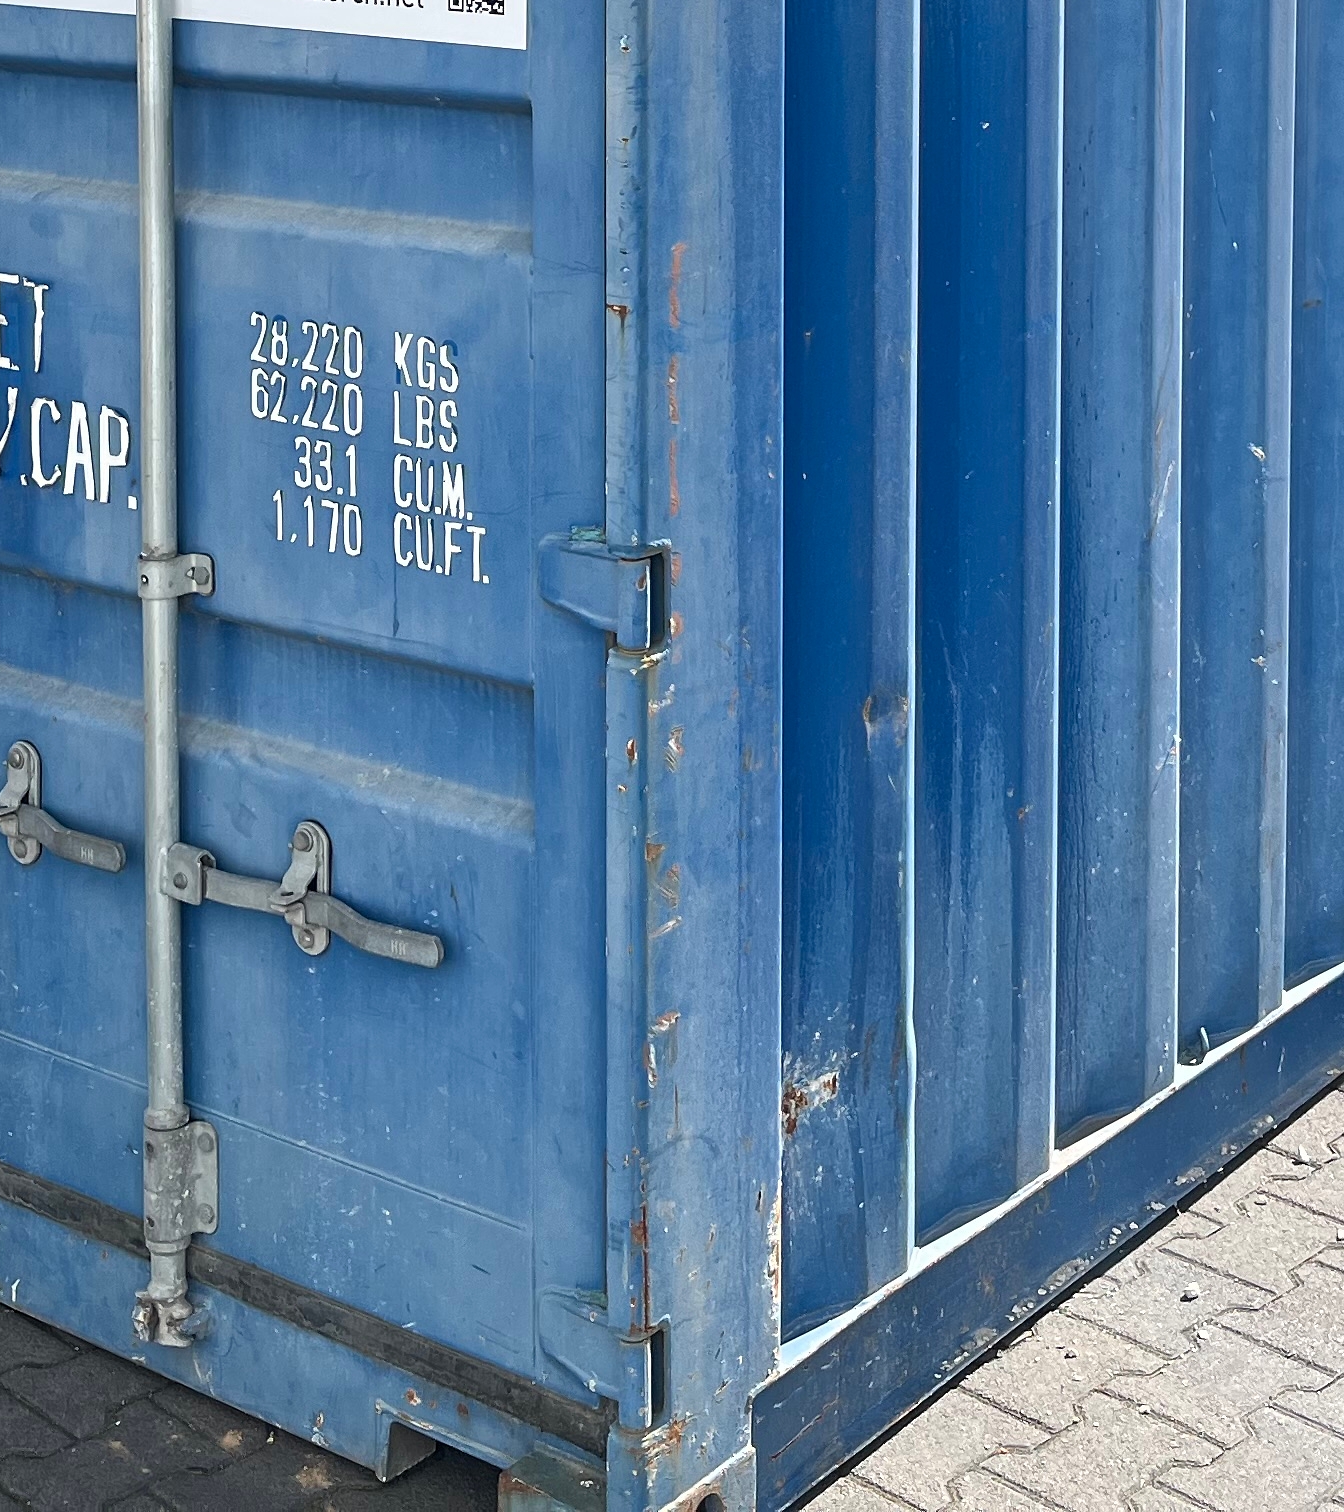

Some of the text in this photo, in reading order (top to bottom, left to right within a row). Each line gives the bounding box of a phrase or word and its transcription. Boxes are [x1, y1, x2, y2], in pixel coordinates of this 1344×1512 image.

[250, 311, 364, 379] 28,220
[393, 331, 460, 393] KGS
[251, 367, 459, 453] 62,220 LBS
[293, 436, 357, 497] 33.1
[393, 453, 474, 521] CU.M.
[272, 489, 491, 585] 1,170 CU.FT.
